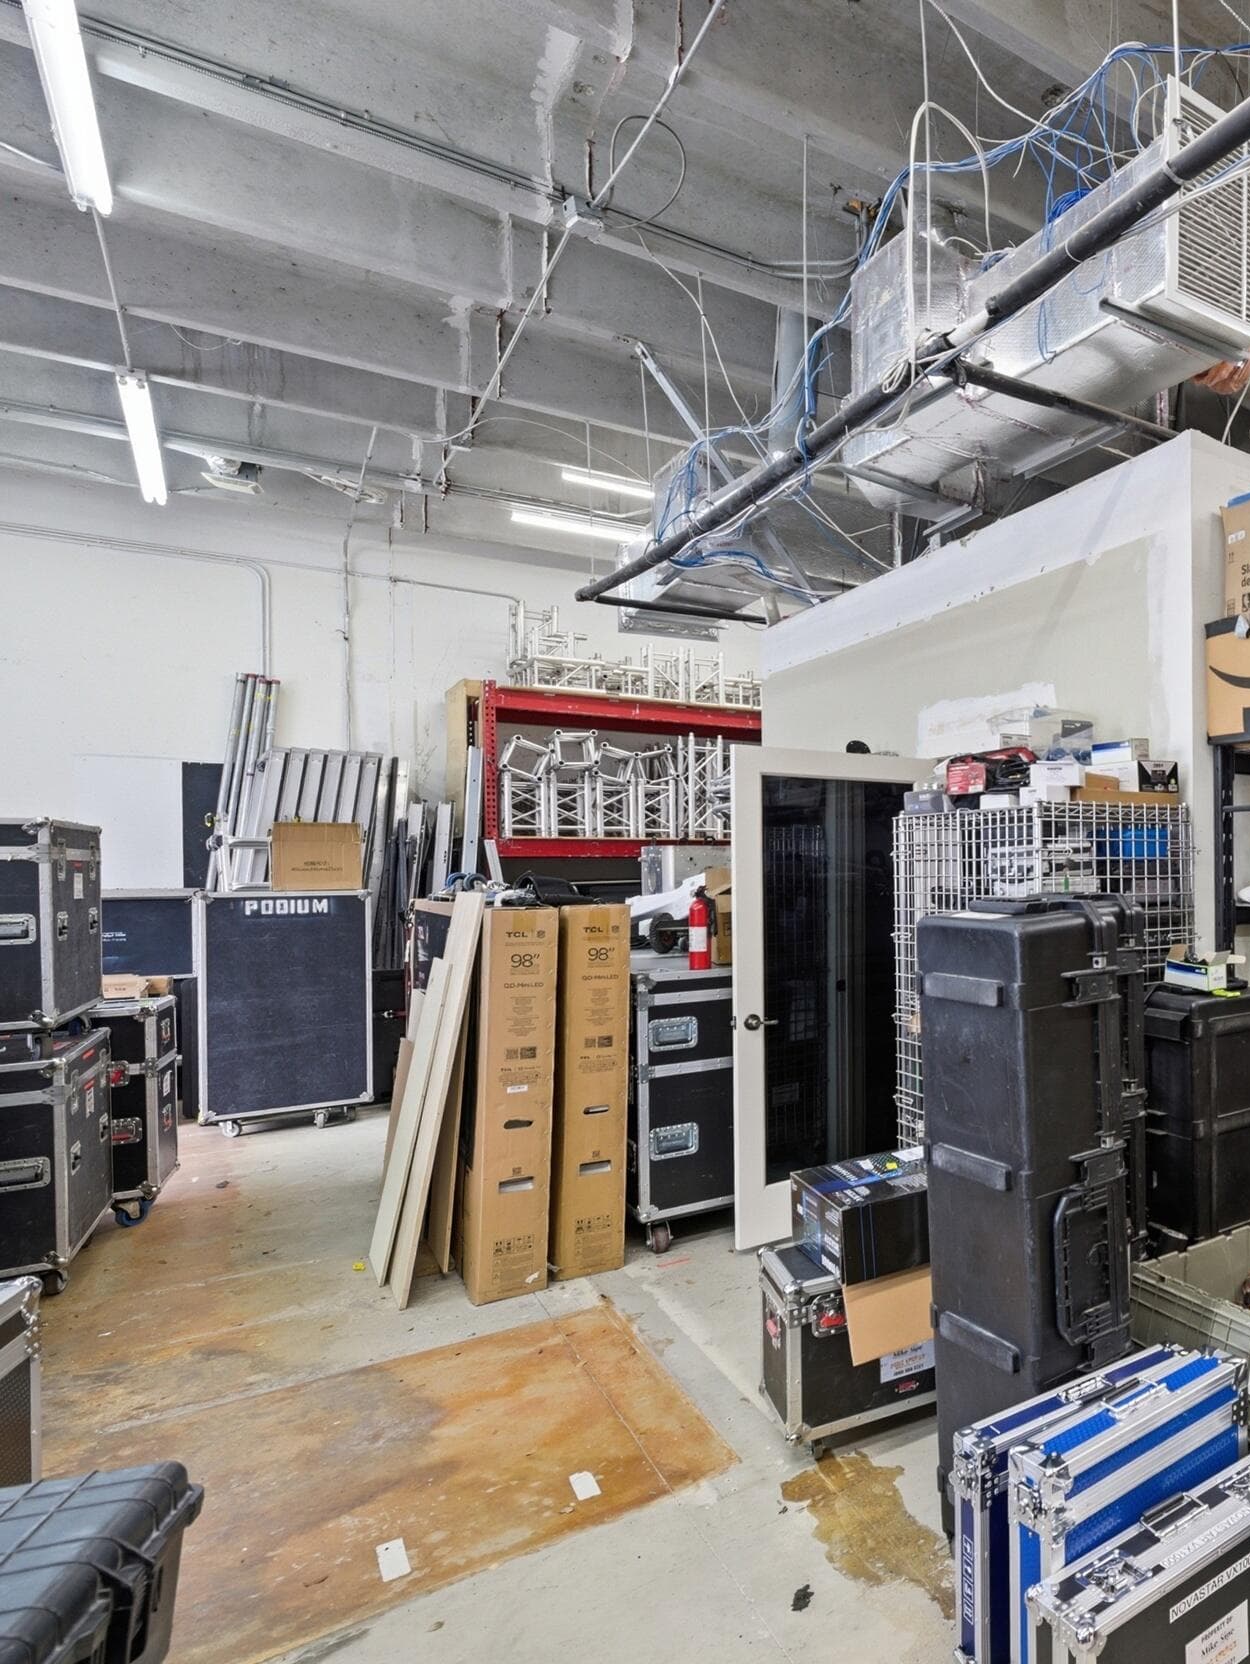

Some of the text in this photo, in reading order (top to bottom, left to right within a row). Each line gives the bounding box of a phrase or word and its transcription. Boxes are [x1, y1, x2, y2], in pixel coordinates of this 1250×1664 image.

[244, 898, 329, 916] PODIUM
[511, 953, 540, 968] 98"
[1171, 1575, 1225, 1620] NOVASTAR
